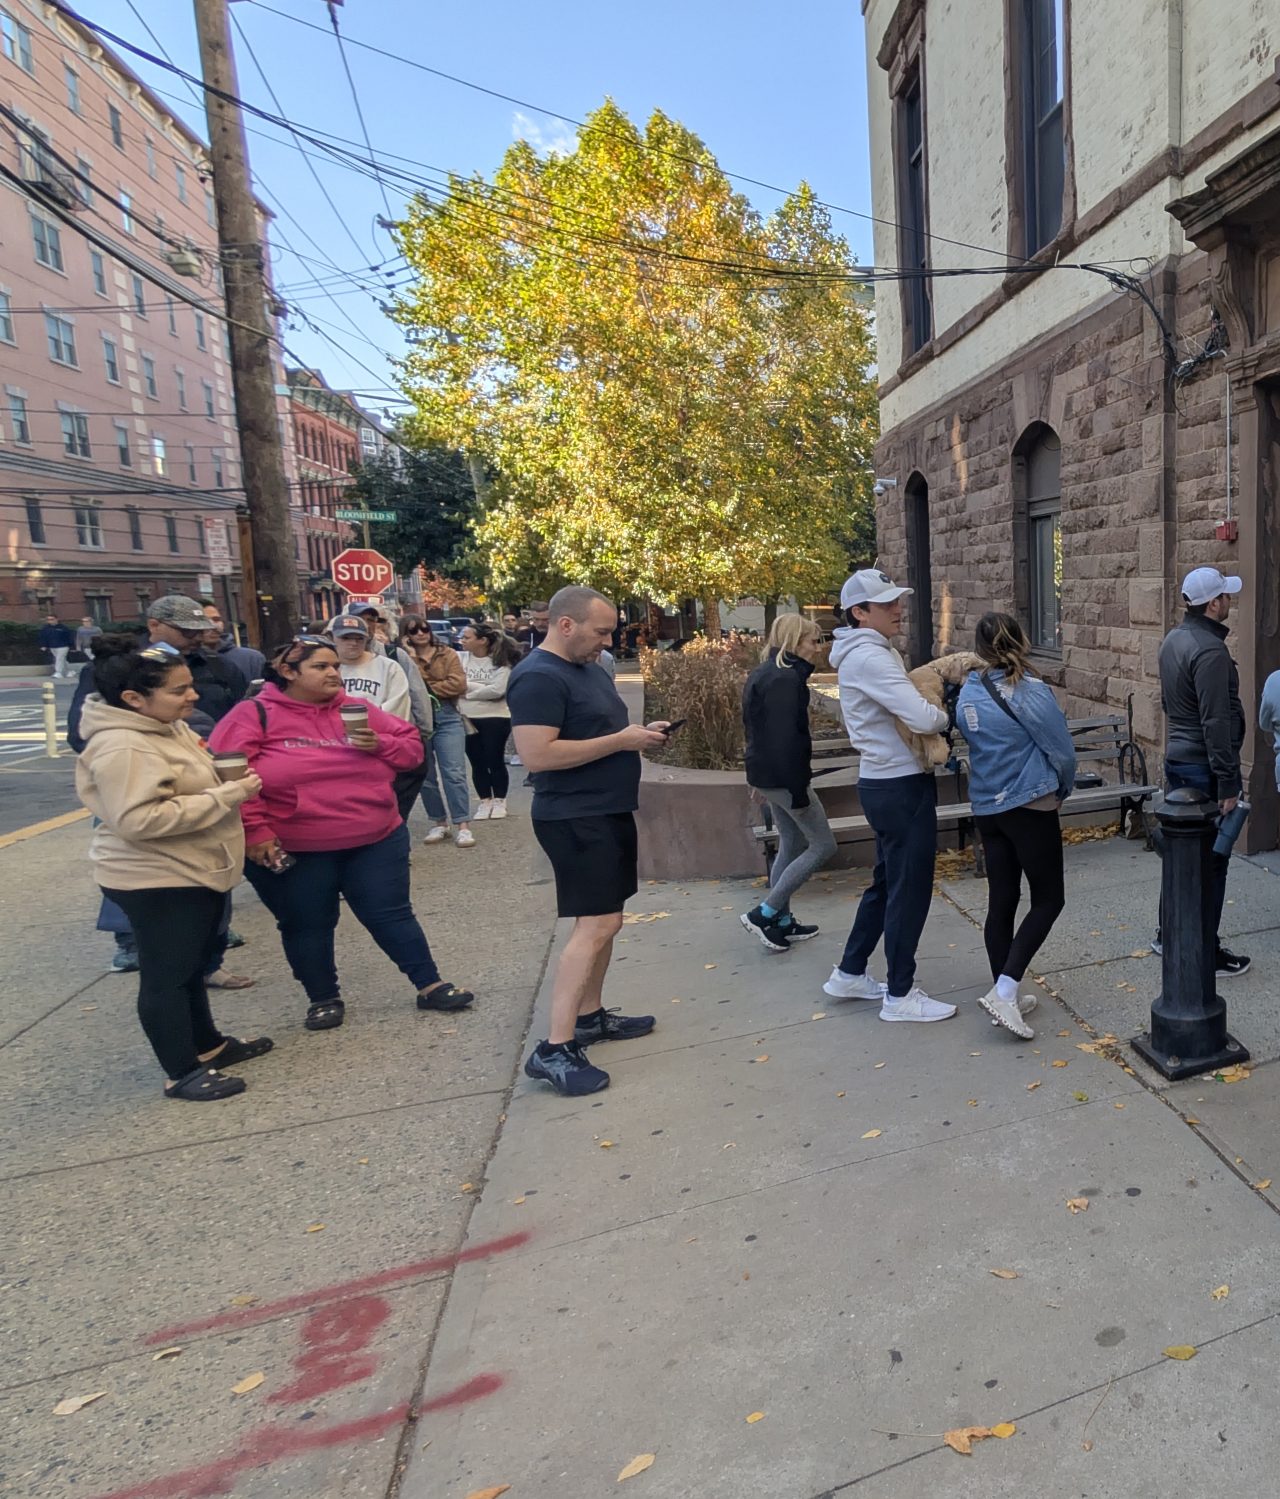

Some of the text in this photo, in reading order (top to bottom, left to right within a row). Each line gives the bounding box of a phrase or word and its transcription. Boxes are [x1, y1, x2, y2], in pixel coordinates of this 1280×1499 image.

[336, 511, 395, 521] BLOOMFIELD ST
[337, 563, 388, 581] STOP
